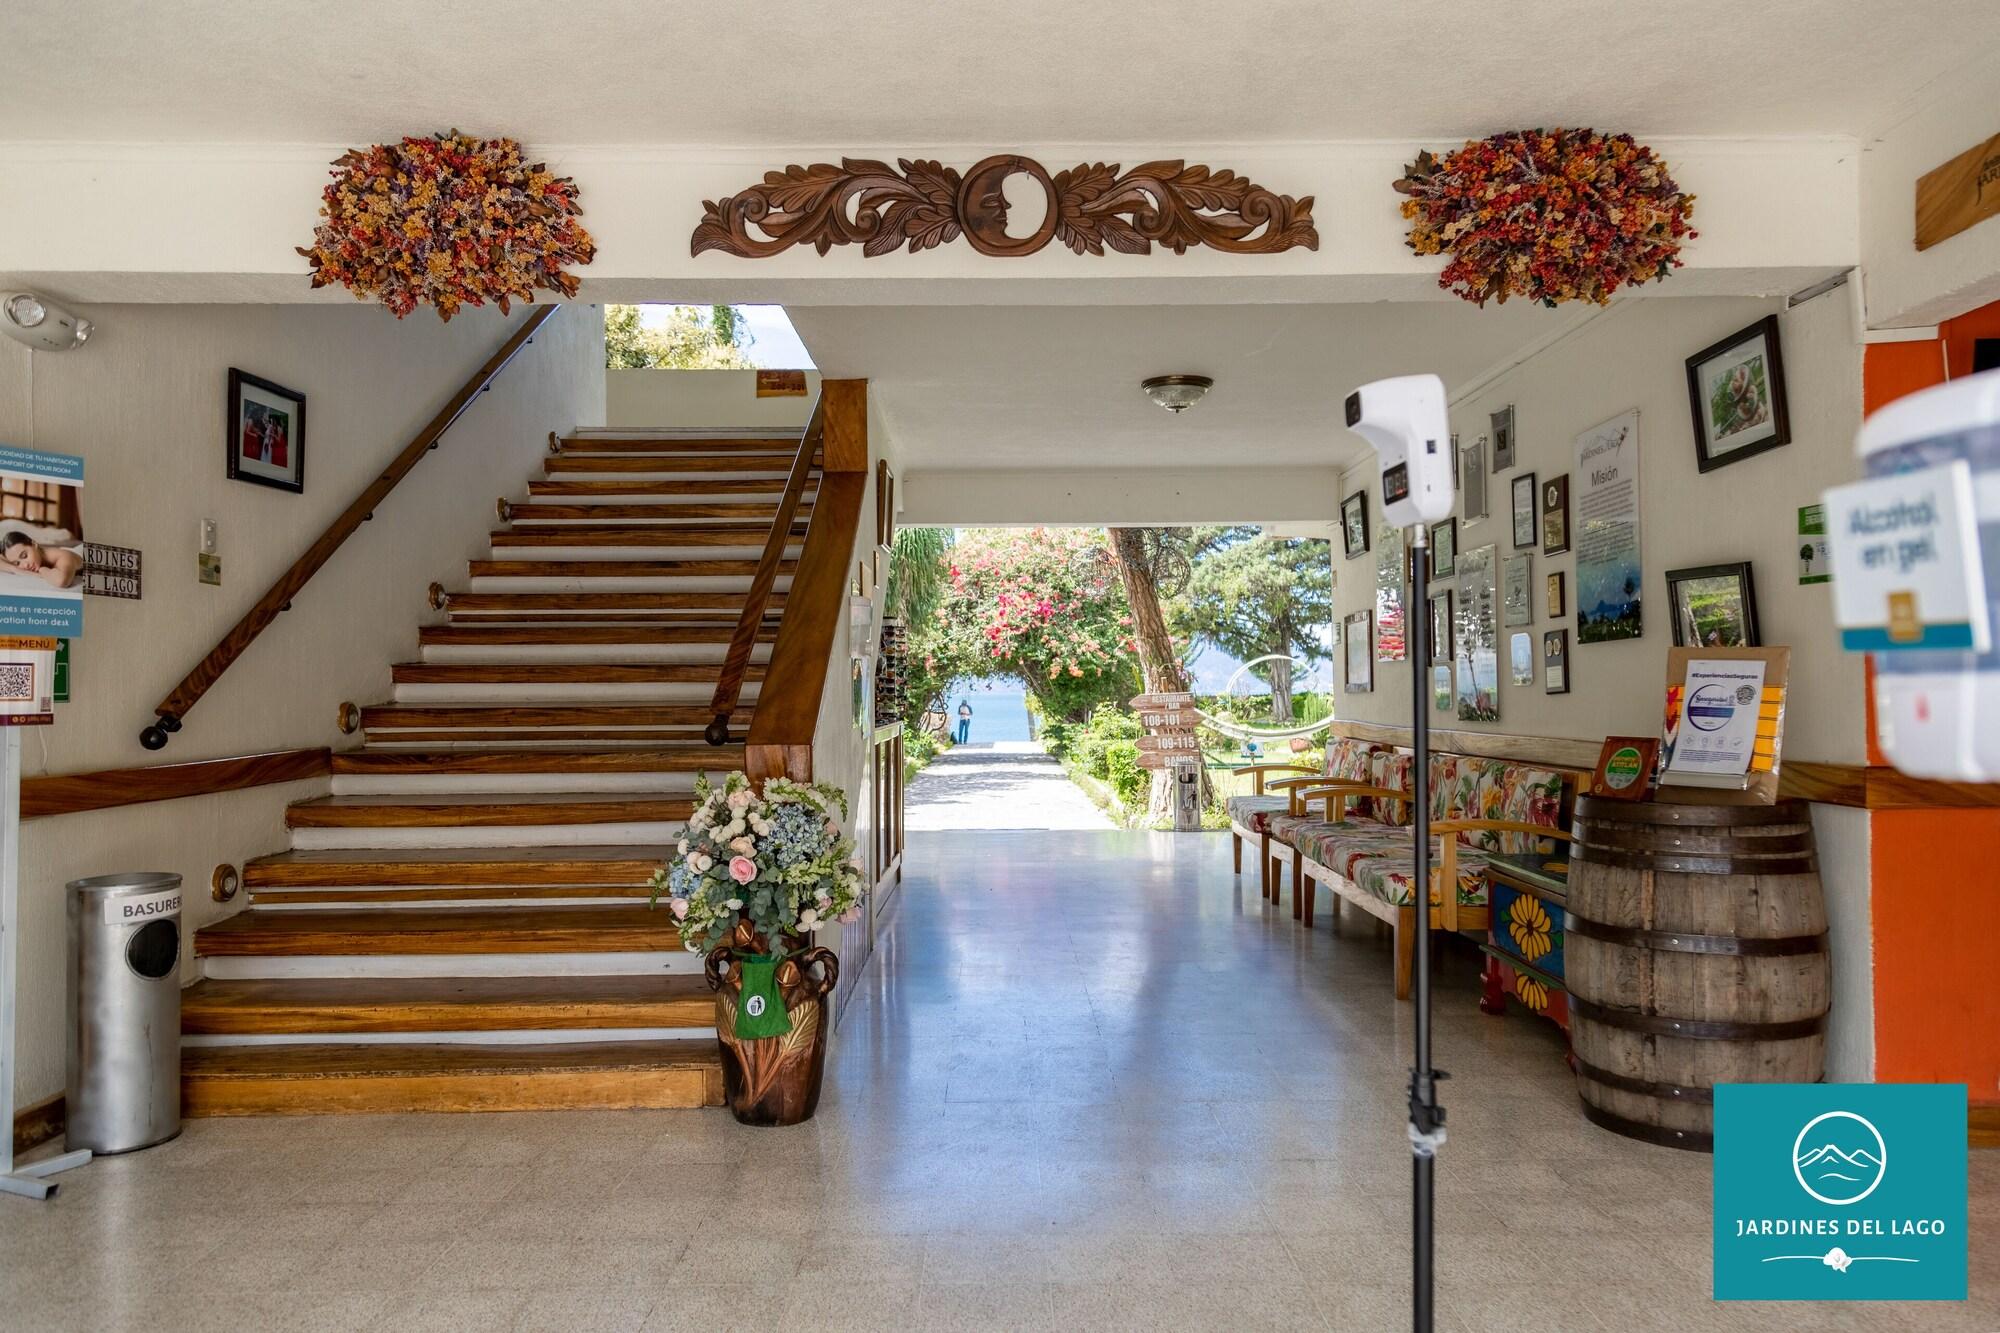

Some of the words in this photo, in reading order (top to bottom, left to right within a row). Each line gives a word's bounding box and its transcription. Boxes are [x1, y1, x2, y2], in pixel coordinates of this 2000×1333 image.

[36, 464, 52, 472] YOUR
[1591, 465, 1618, 487] Misión
[1850, 499, 1938, 534] Alcohol
[1862, 545, 1893, 568] en
[104, 576, 134, 593] LAGO
[34, 607, 76, 616] recepción
[28, 617, 48, 625] front
[50, 618, 70, 626] desk
[19, 638, 50, 648] MENÚ
[1152, 694, 1191, 703] RESTAURANTE
[1143, 714, 1180, 726] 108-101
[1156, 736, 1195, 749] 109-115
